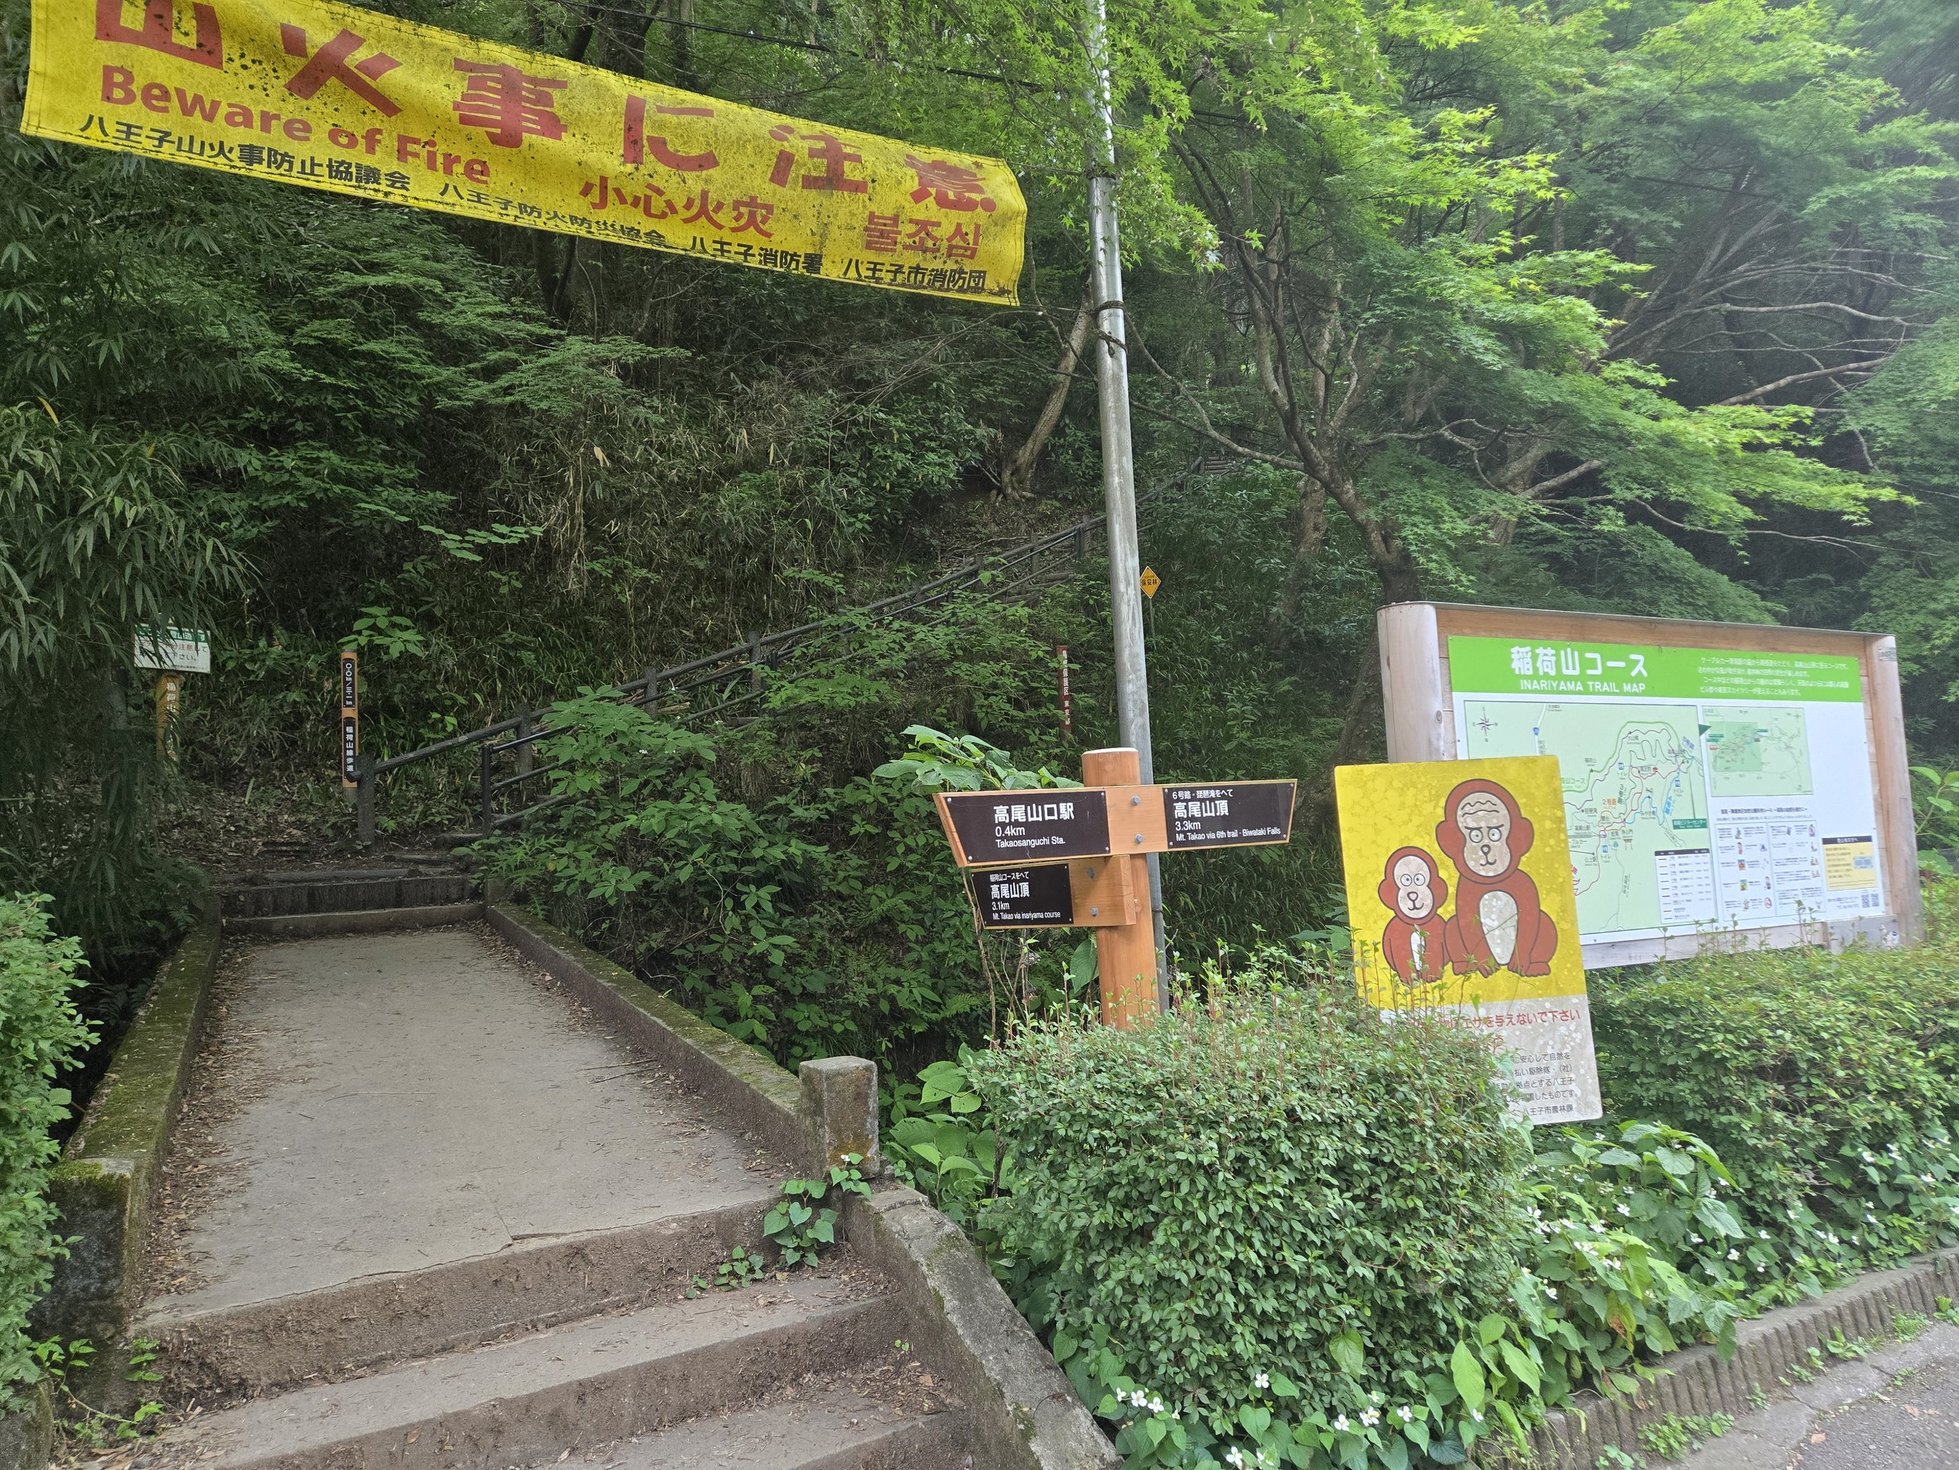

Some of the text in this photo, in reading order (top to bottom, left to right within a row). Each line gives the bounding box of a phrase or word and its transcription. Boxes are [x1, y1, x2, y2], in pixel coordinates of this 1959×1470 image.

[101, 64, 491, 185] Beware of Fire
[80, 113, 411, 192] 八王子山火事防止協議会
[690, 235, 824, 276] 八王子消防署
[842, 256, 988, 294] 八王子市消防団
[579, 175, 774, 238] 小心火灾
[863, 211, 982, 260] 불조심
[1510, 645, 1648, 677] 稲荷山コース
[1520, 679, 1646, 693] INARIYAMA TRAIL MAP
[993, 802, 1075, 824] 高尾山口駅
[1173, 800, 1230, 819] 高尾山頂
[995, 825, 1026, 837] 0.4km
[1175, 820, 1202, 831] 3.3km
[1176, 826, 1281, 842] Mt. Takao via 6th trail Biwataki Falls
[996, 835, 1066, 848] Takaosanguchi Sta.
[990, 882, 1030, 900] 高尾山頂
[992, 901, 1011, 911] 3.1km
[992, 912, 1000, 920] Mt.
[1000, 912, 1014, 920] Takao
[1044, 911, 1061, 919] course
